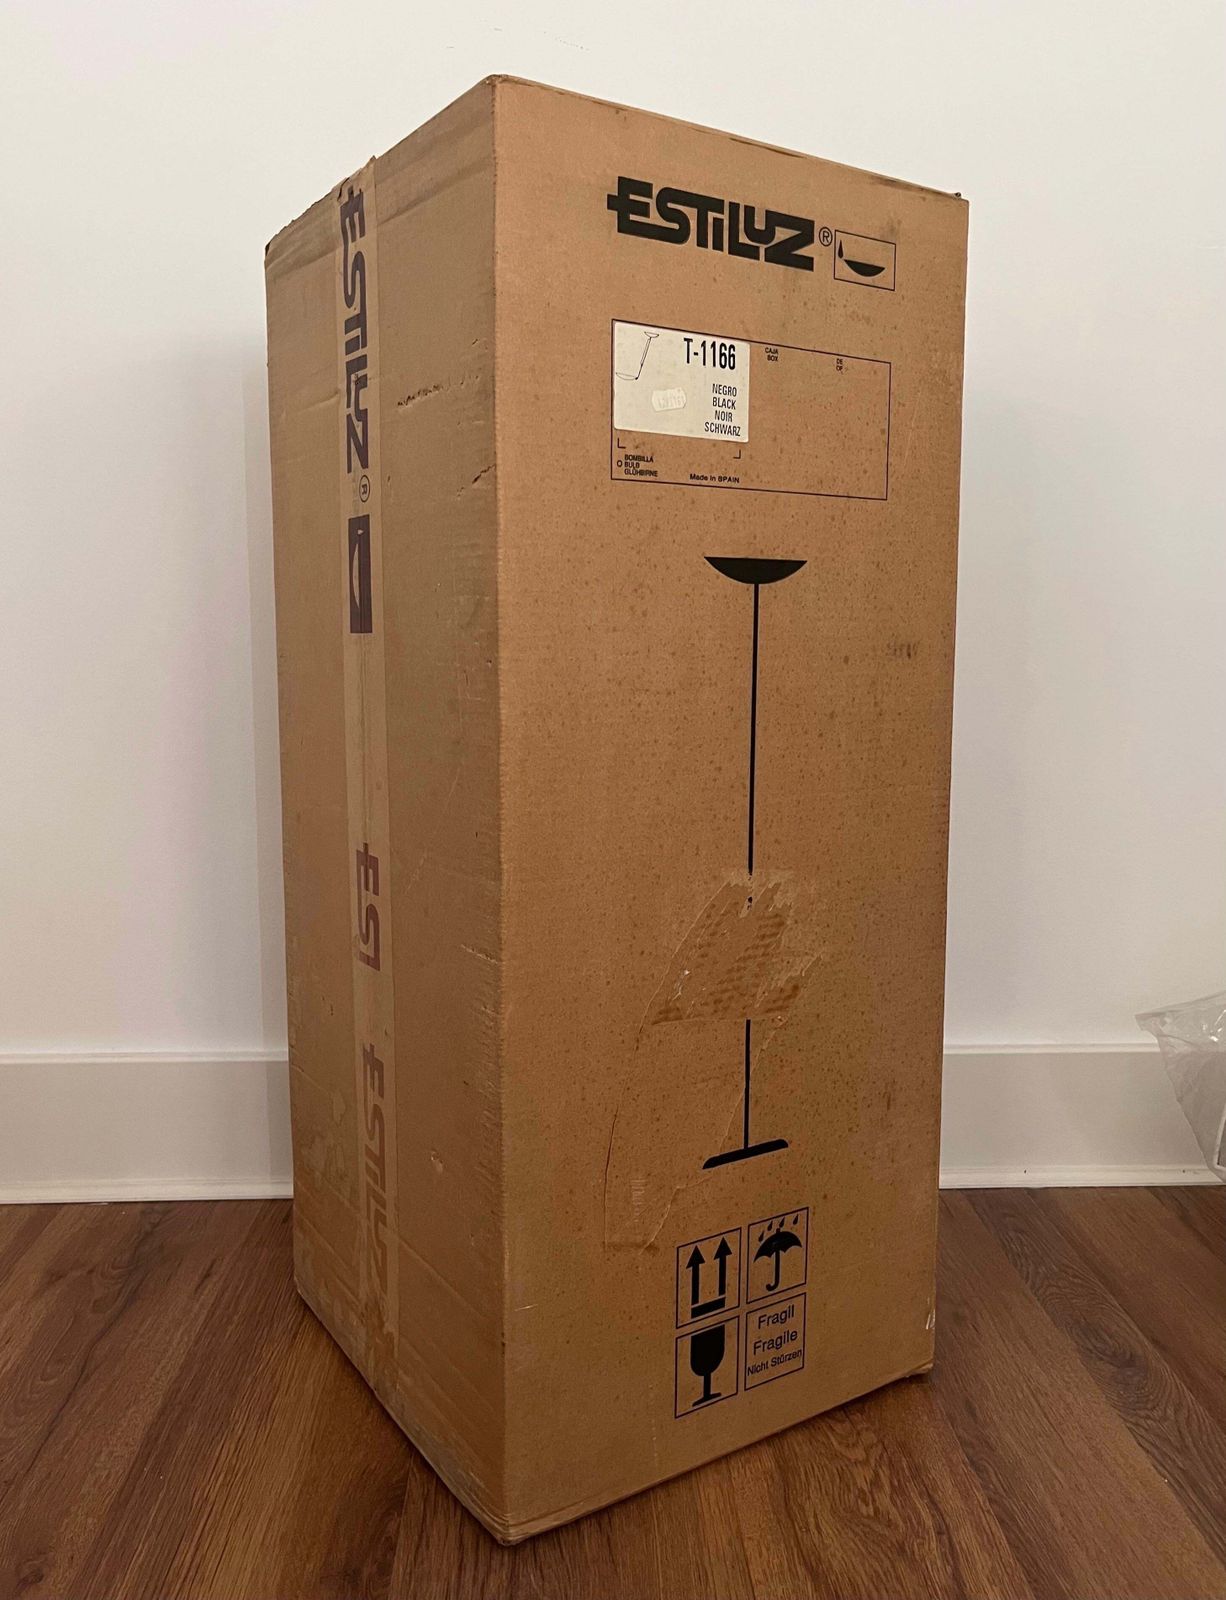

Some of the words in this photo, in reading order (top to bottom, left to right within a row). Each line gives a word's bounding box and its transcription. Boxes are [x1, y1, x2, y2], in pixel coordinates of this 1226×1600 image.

[683, 337, 736, 370] T-1166
[766, 354, 779, 362] BOX
[712, 383, 738, 397] NEGRO
[712, 396, 737, 410] BLACK
[714, 410, 733, 422] NOIR
[704, 421, 741, 436] SCHWARZ
[624, 461, 640, 469] BULB
[690, 473, 709, 481] Made
[718, 475, 740, 483] SPAIN
[758, 1304, 794, 1329] Fragil
[753, 1330, 798, 1355] Fragile
[747, 1361, 768, 1376] Nicht
[770, 1349, 802, 1367] Stürzen
